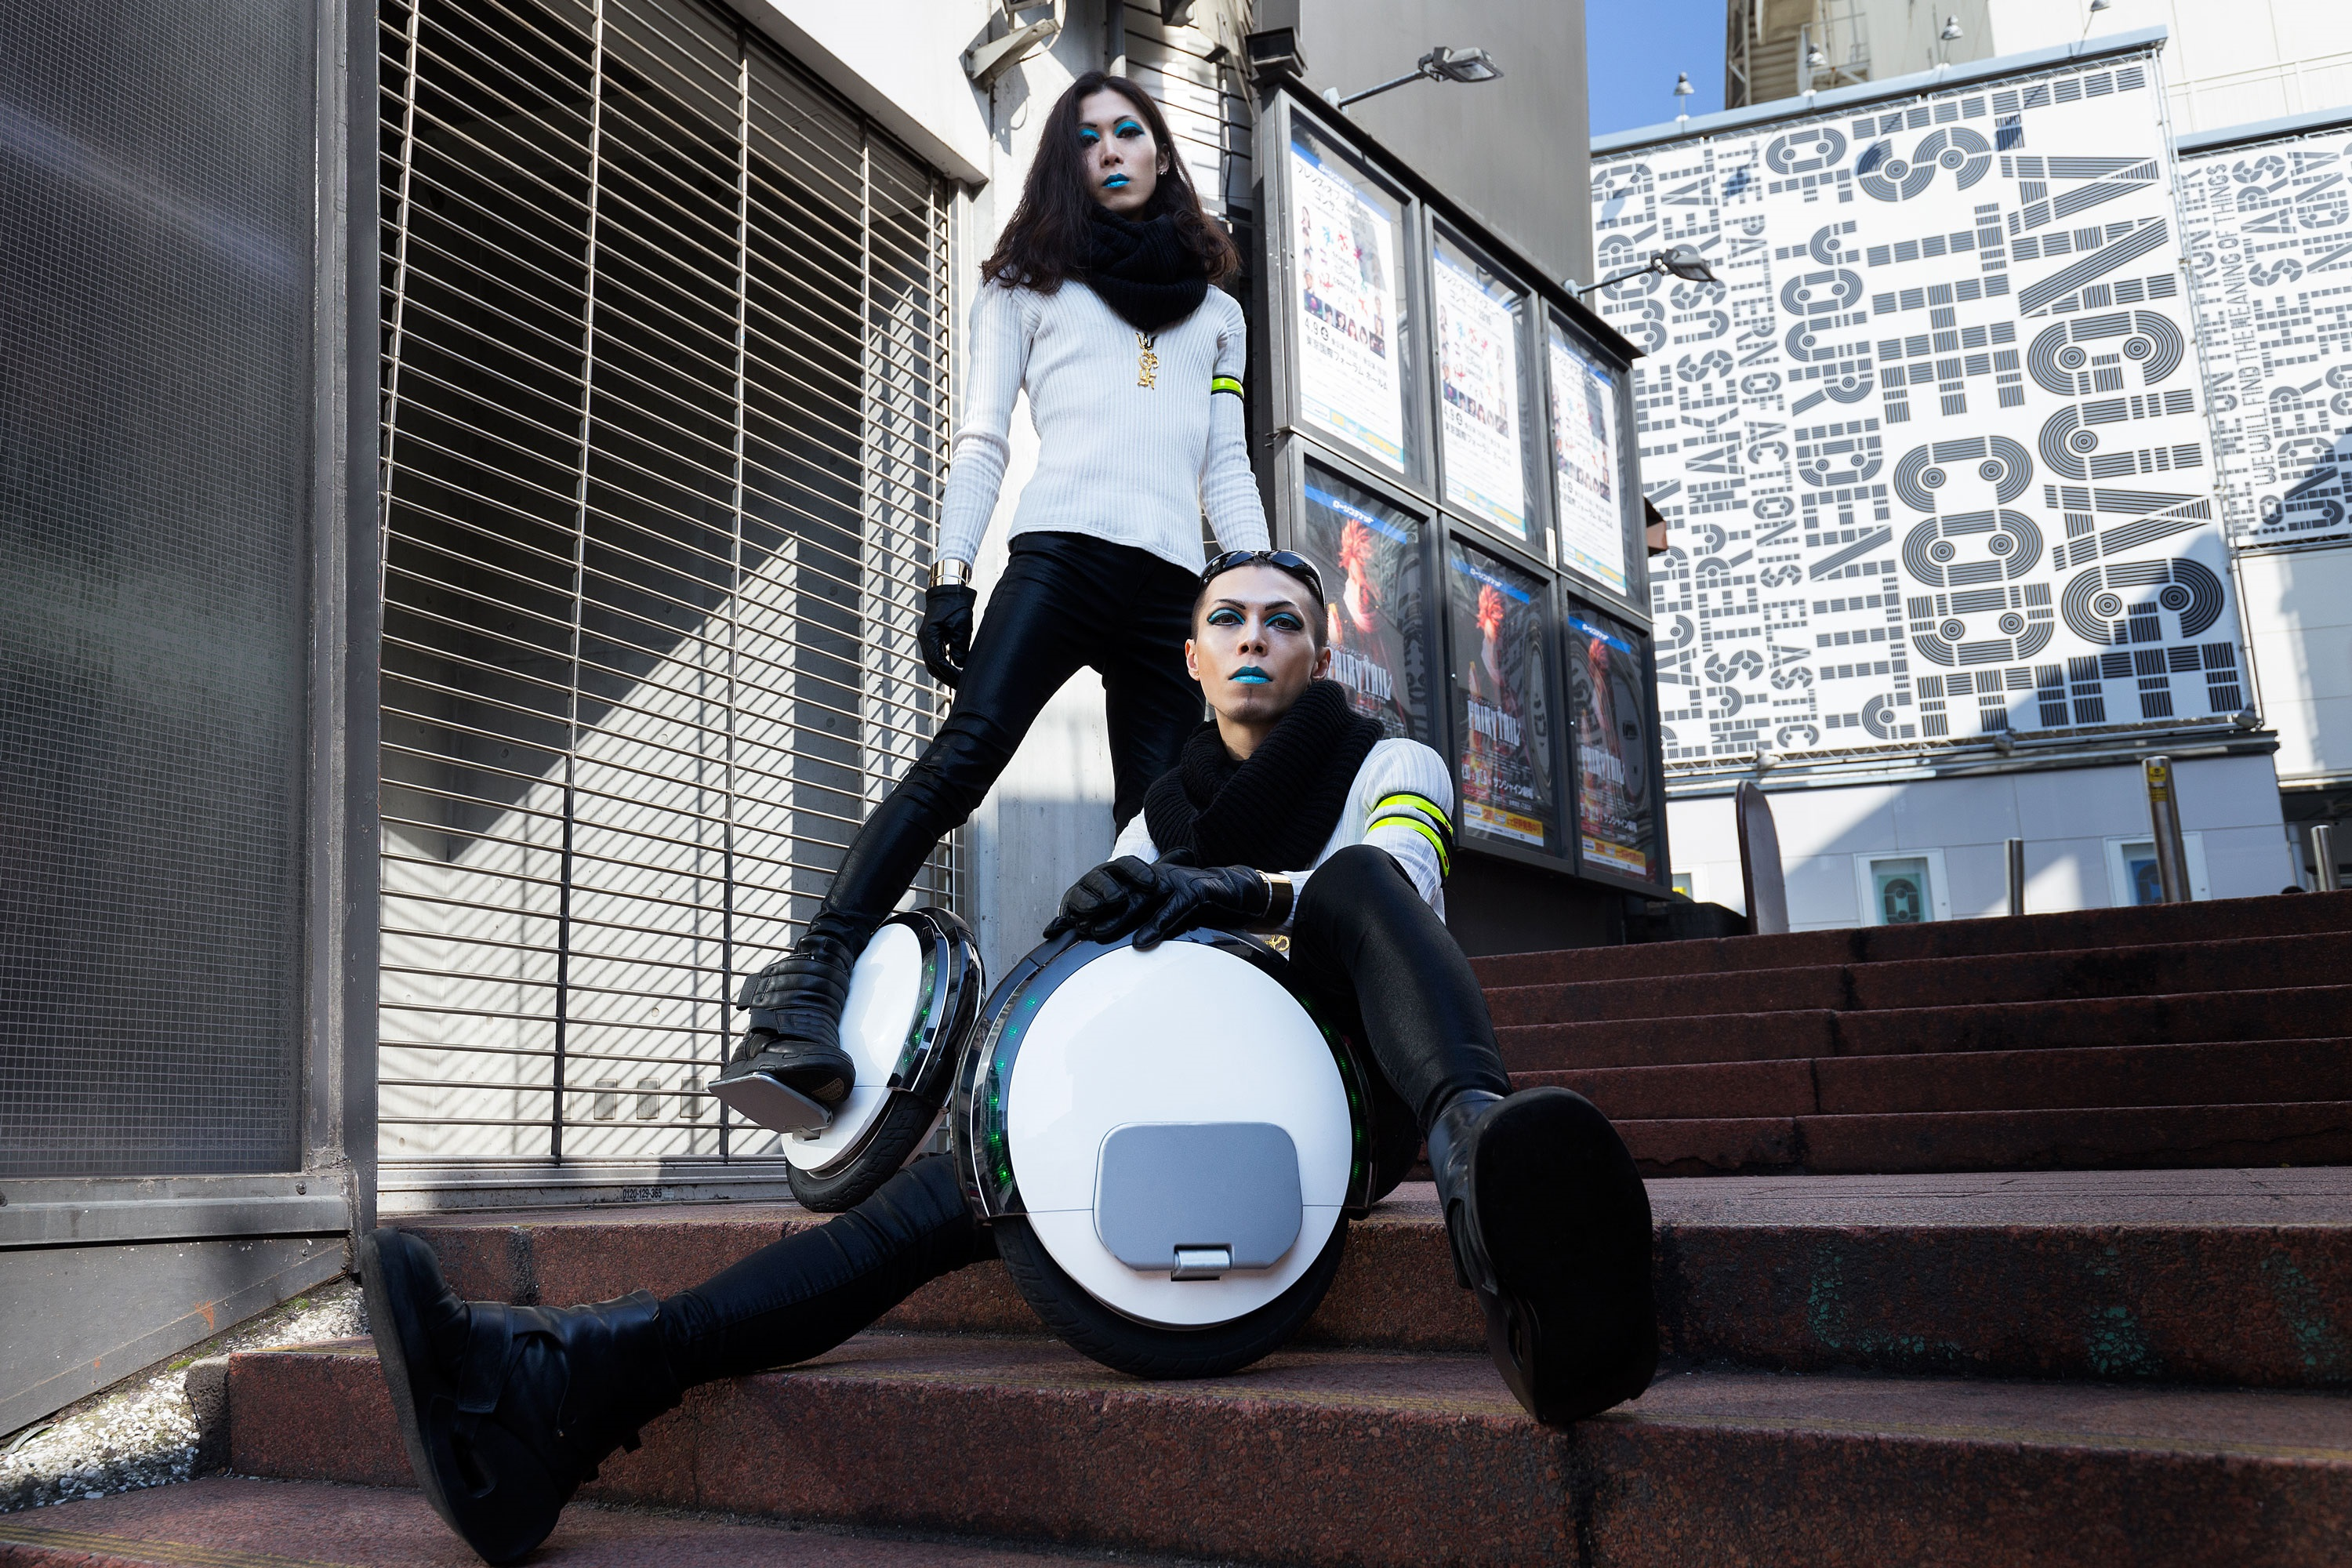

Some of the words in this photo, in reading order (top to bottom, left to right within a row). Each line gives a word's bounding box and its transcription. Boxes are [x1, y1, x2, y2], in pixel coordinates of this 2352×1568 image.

[1718, 140, 1762, 207] THE
[1766, 128, 1853, 203] OF
[1852, 96, 1992, 202] IS
[2205, 163, 2235, 226] THINGS
[2231, 154, 2303, 287] STARS
[2287, 151, 2350, 229] AND
[2216, 230, 2239, 249] OF
[2302, 230, 2352, 274] IN
[1670, 278, 1730, 345] US
[1725, 215, 1780, 367] PATTERN
[1775, 220, 1875, 417] YOUR
[1867, 202, 2025, 424] THE
[2220, 252, 2252, 329] MEANING
[2232, 329, 2258, 365] THE
[2252, 292, 2319, 378] THE
[1740, 372, 1784, 412] OF
[1992, 66, 2242, 724] LANGUAGE
[2238, 366, 2265, 406] FIND
[1676, 350, 1748, 514] MAKES
[2245, 408, 2271, 453] WILL
[2269, 377, 2346, 532] UNDER
[1744, 420, 1798, 546] ACTION
[2252, 456, 2277, 486] WE
[1759, 554, 1802, 588] IS
[1794, 417, 1915, 739] IDENTITY
[1894, 435, 2069, 738] CODE
[1327, 648, 1362, 694] FAIRY
[1692, 524, 1773, 754] MYSTERY
[1763, 599, 1820, 748] ELASTIC
[1467, 698, 1497, 742] FAIRY
[622, 1188, 662, 1199] 0120-129-365
